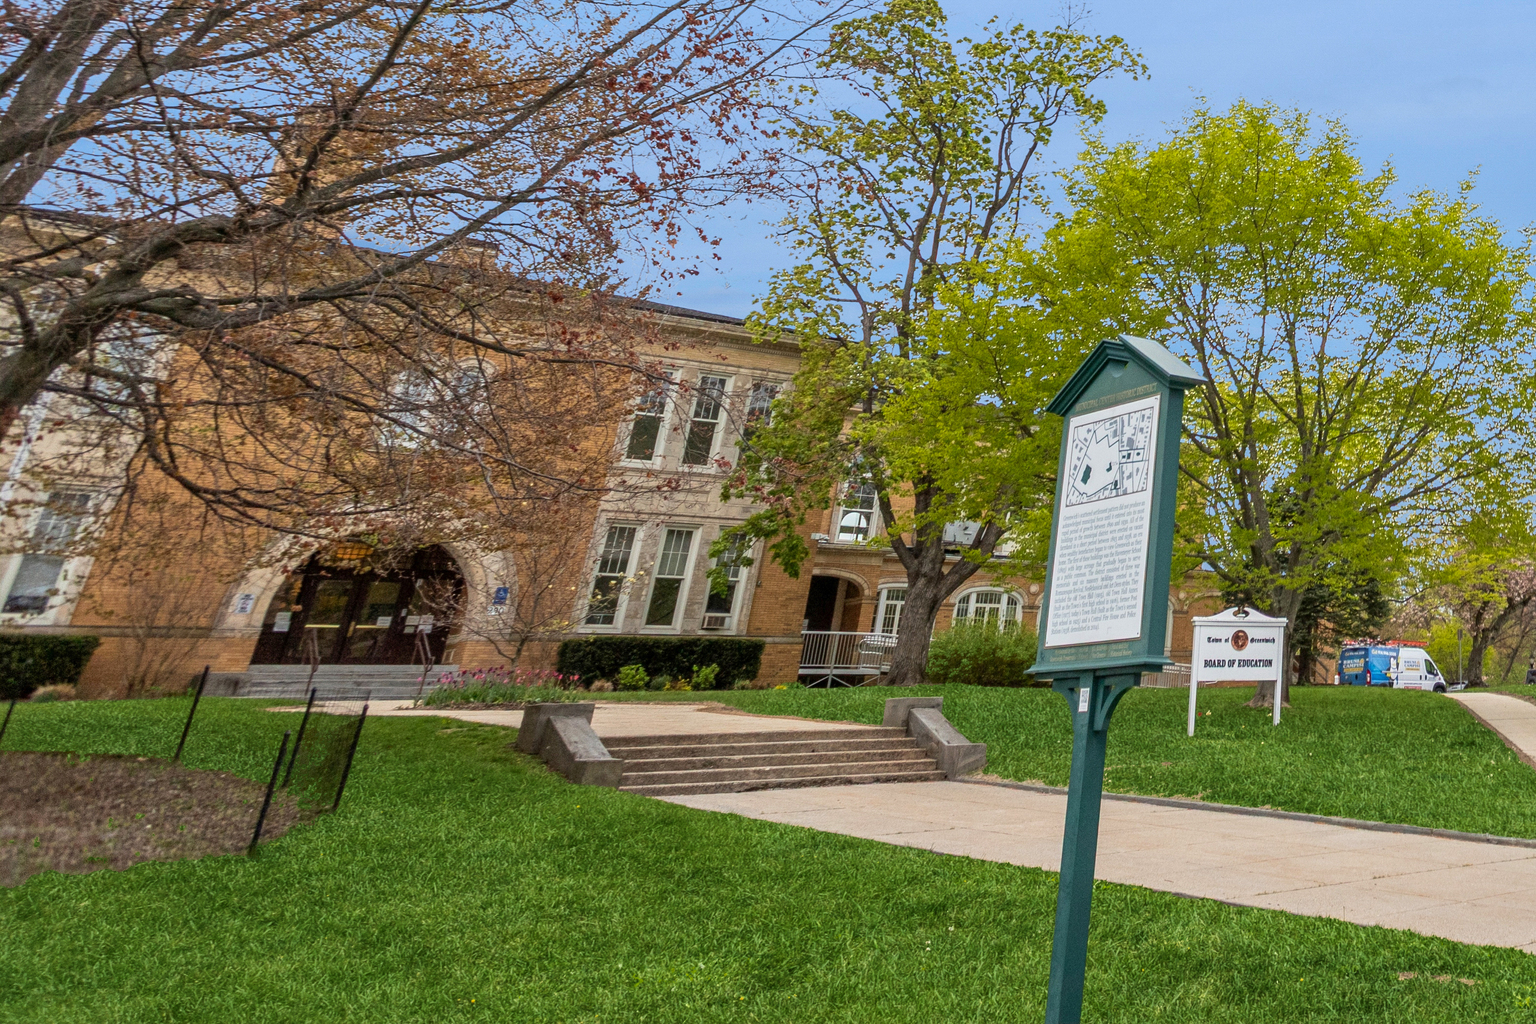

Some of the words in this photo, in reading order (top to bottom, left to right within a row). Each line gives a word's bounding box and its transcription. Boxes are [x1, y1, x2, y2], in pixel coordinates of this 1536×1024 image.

[1204, 659, 1226, 668] BOARD
[1227, 659, 1236, 668] OF
[1237, 659, 1273, 668] EDUCATION
